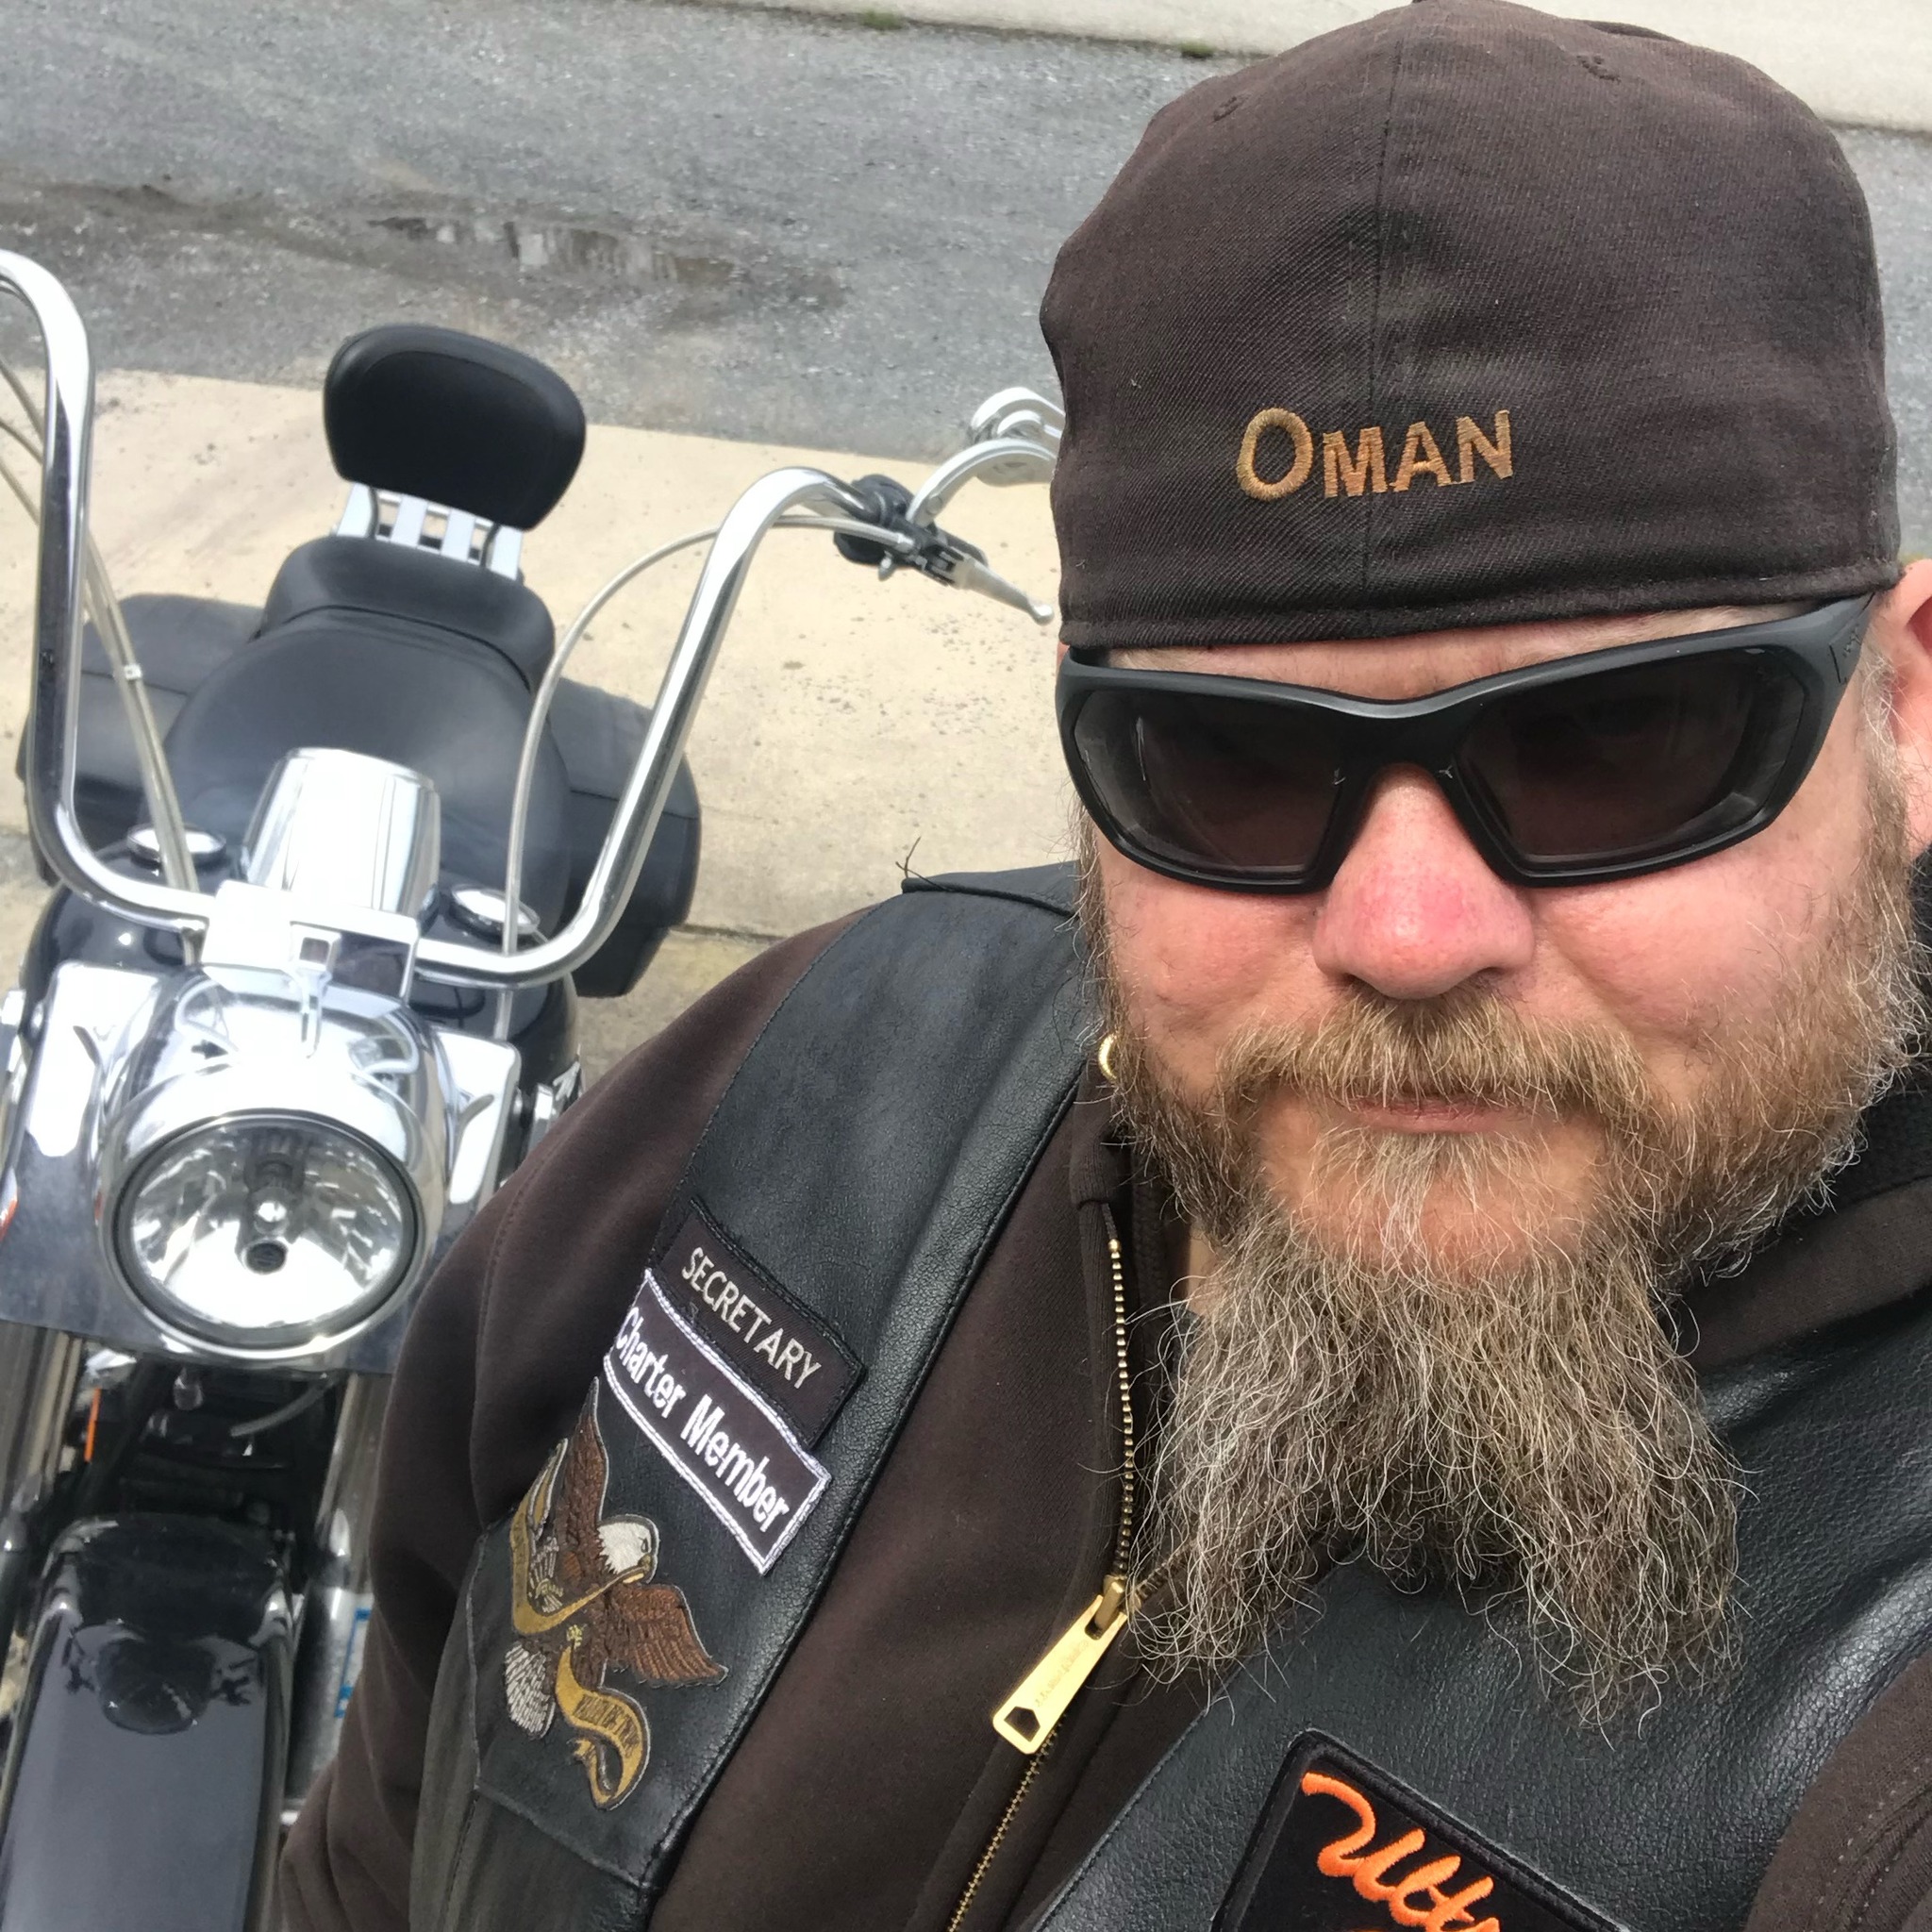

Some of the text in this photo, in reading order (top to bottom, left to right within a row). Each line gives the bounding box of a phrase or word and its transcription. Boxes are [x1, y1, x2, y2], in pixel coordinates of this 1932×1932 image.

[681, 1246, 822, 1389] SECRETARY
[616, 1307, 790, 1533] Charter Member
